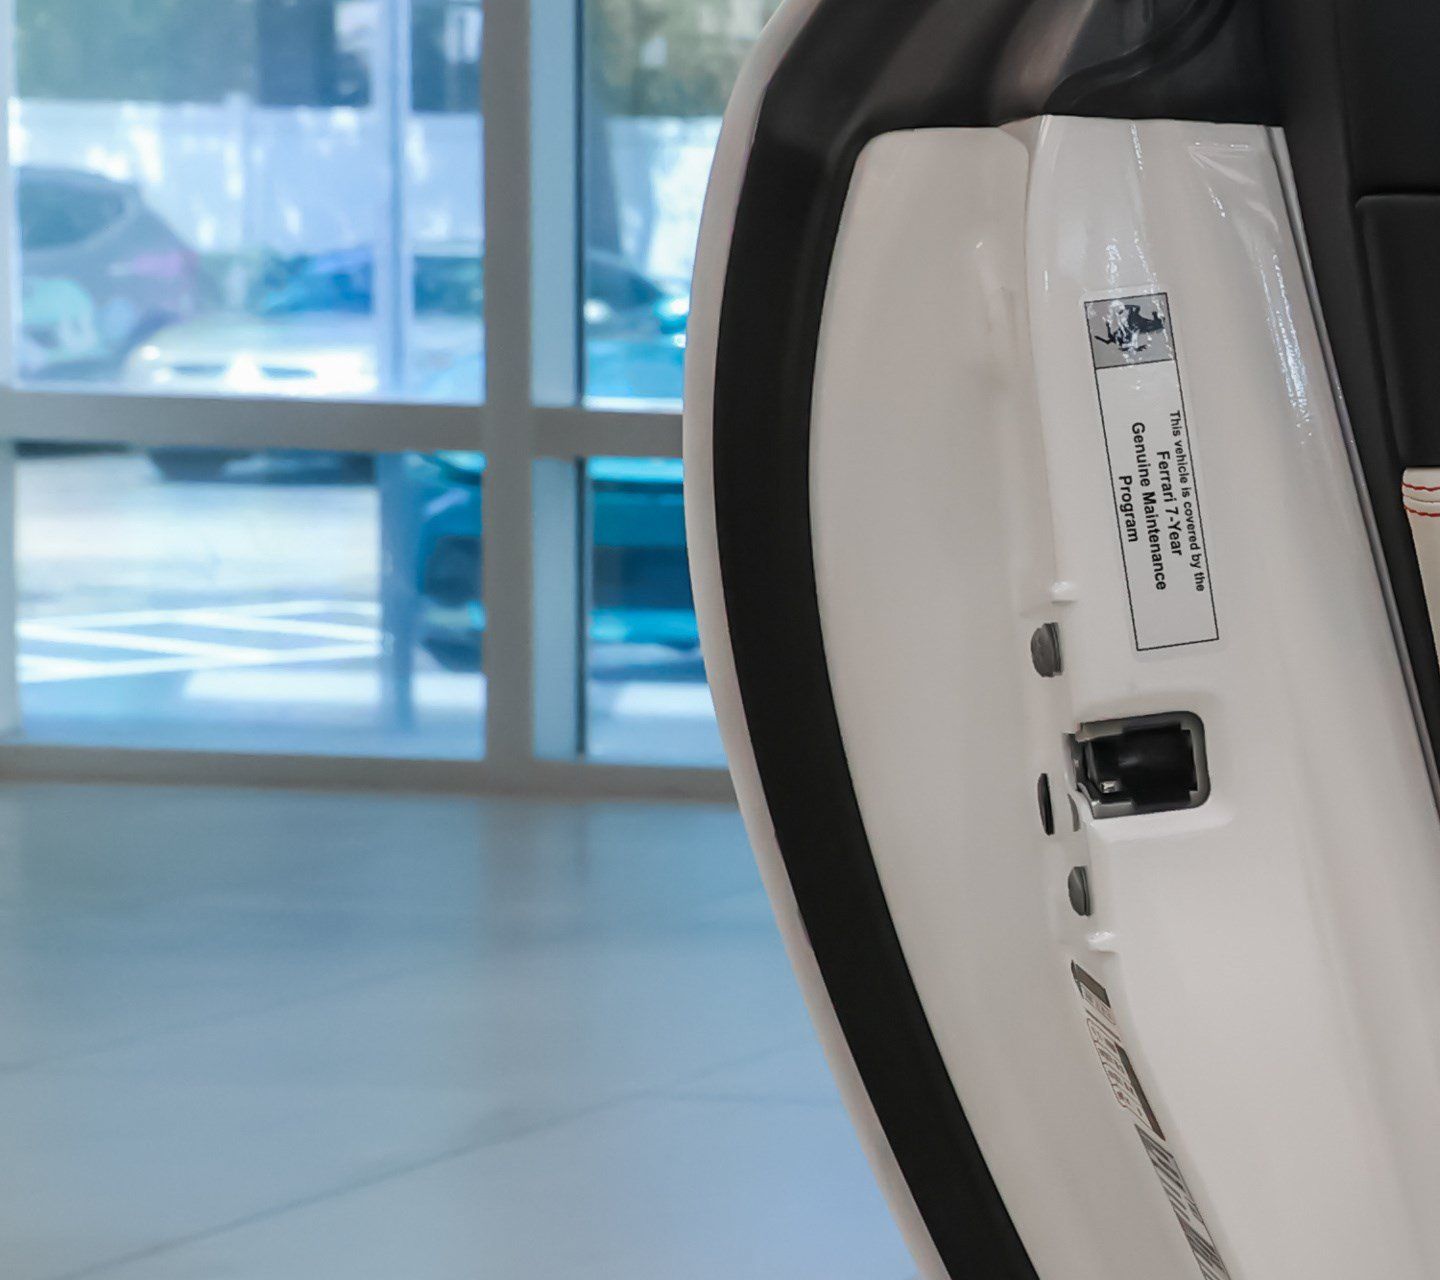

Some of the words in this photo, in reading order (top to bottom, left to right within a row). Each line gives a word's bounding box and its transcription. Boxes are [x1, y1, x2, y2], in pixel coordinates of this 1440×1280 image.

[1170, 410, 1182, 437] This
[1156, 451, 1177, 502] Ferrari
[1174, 440, 1190, 484] vehicle
[1118, 475, 1138, 543] Program
[1131, 422, 1151, 487] Genuine
[1142, 491, 1166, 590] Maintenance
[1181, 487, 1192, 498] is
[1165, 506, 1182, 556] 7-Year
[1183, 501, 1201, 550] covered
[1189, 553, 1202, 569] by
[1194, 572, 1205, 592] the
